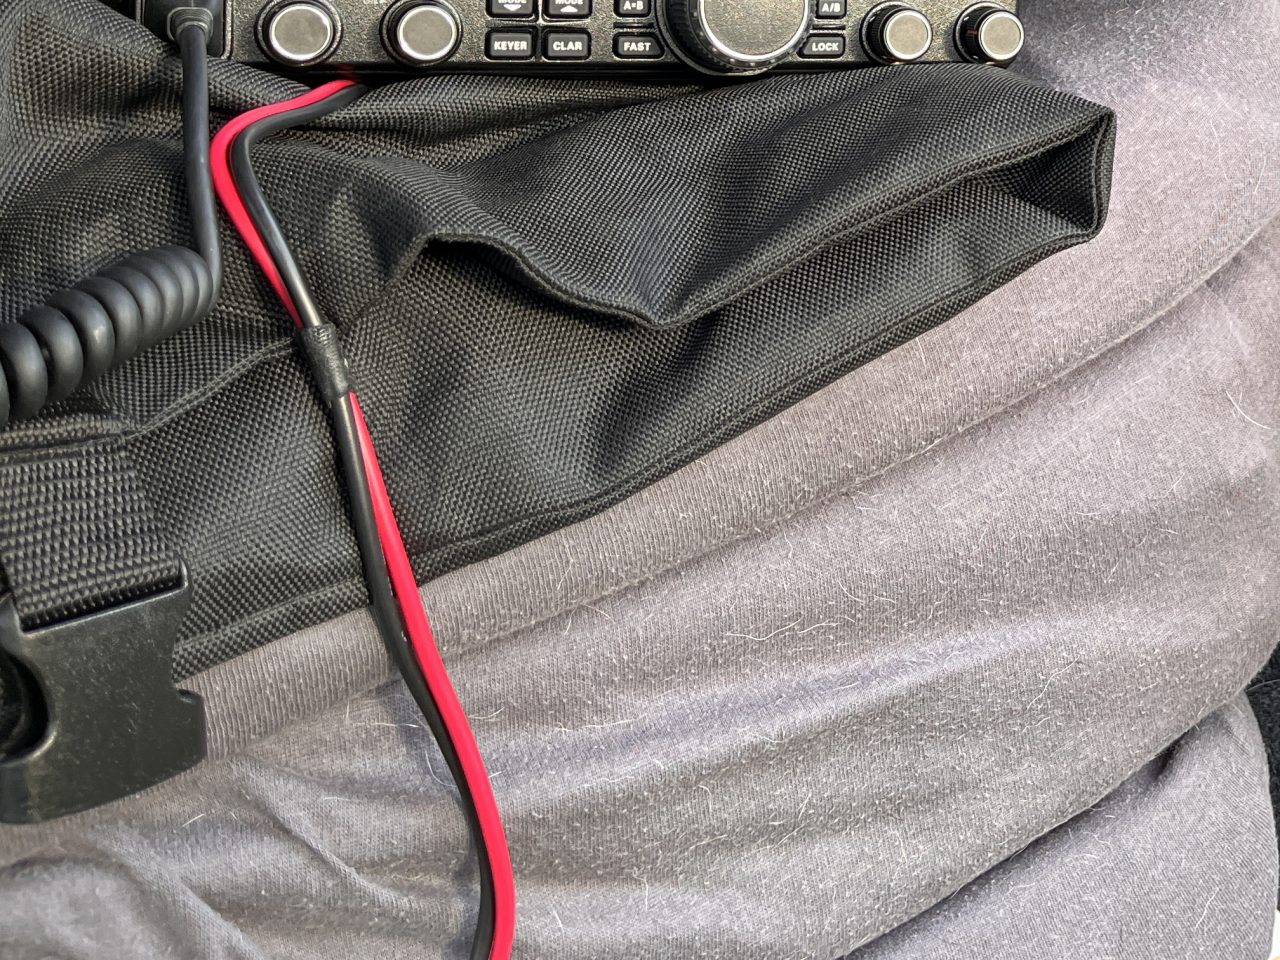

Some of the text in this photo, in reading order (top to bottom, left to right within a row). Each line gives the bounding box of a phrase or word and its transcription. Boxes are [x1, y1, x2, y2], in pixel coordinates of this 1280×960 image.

[821, 2, 842, 13] A/B
[493, 40, 528, 52] KEYER
[552, 41, 583, 52] CLAR
[623, 42, 652, 53] FAST
[811, 41, 840, 53] LOCK
